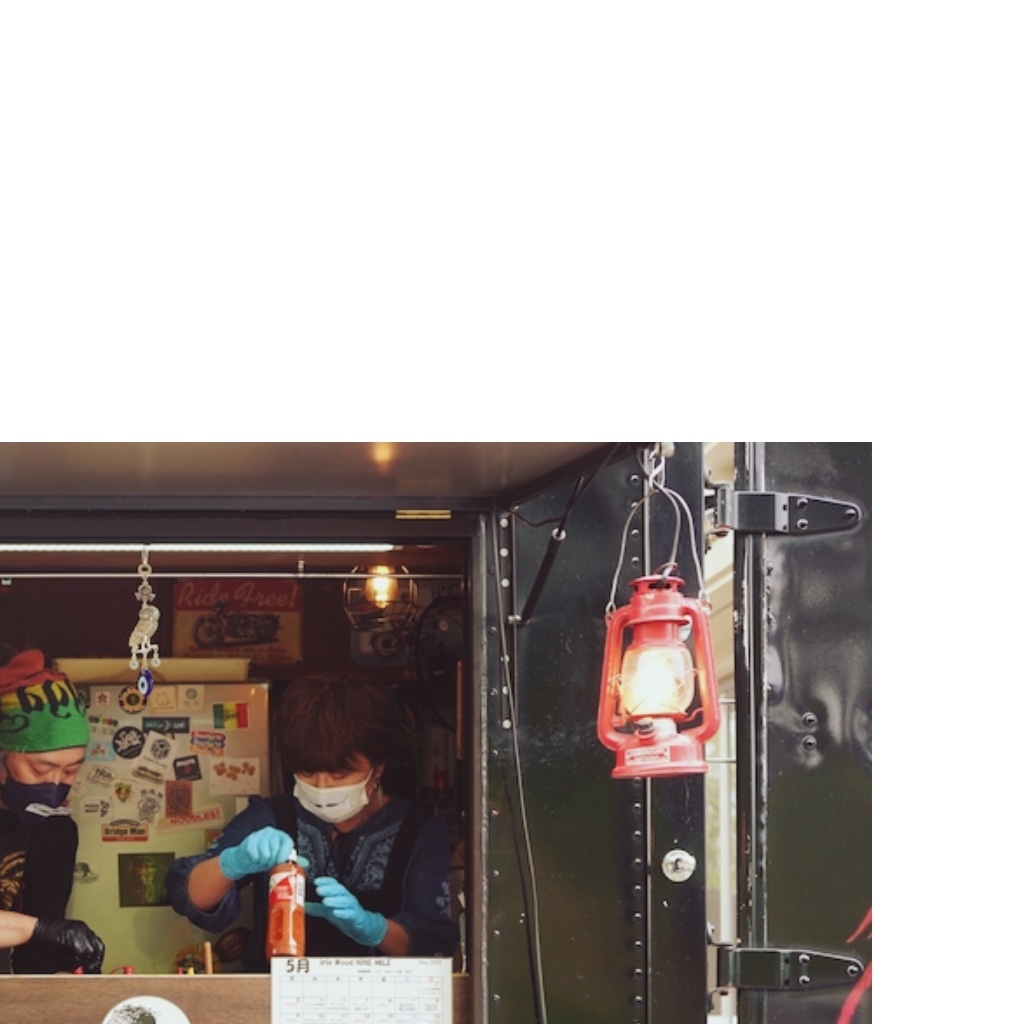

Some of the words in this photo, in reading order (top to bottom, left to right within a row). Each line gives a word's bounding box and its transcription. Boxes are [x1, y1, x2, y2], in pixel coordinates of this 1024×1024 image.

[178, 582, 229, 607] Ride
[234, 582, 299, 608] Free!
[130, 827, 146, 836] Man
[285, 959, 310, 973] 5月
